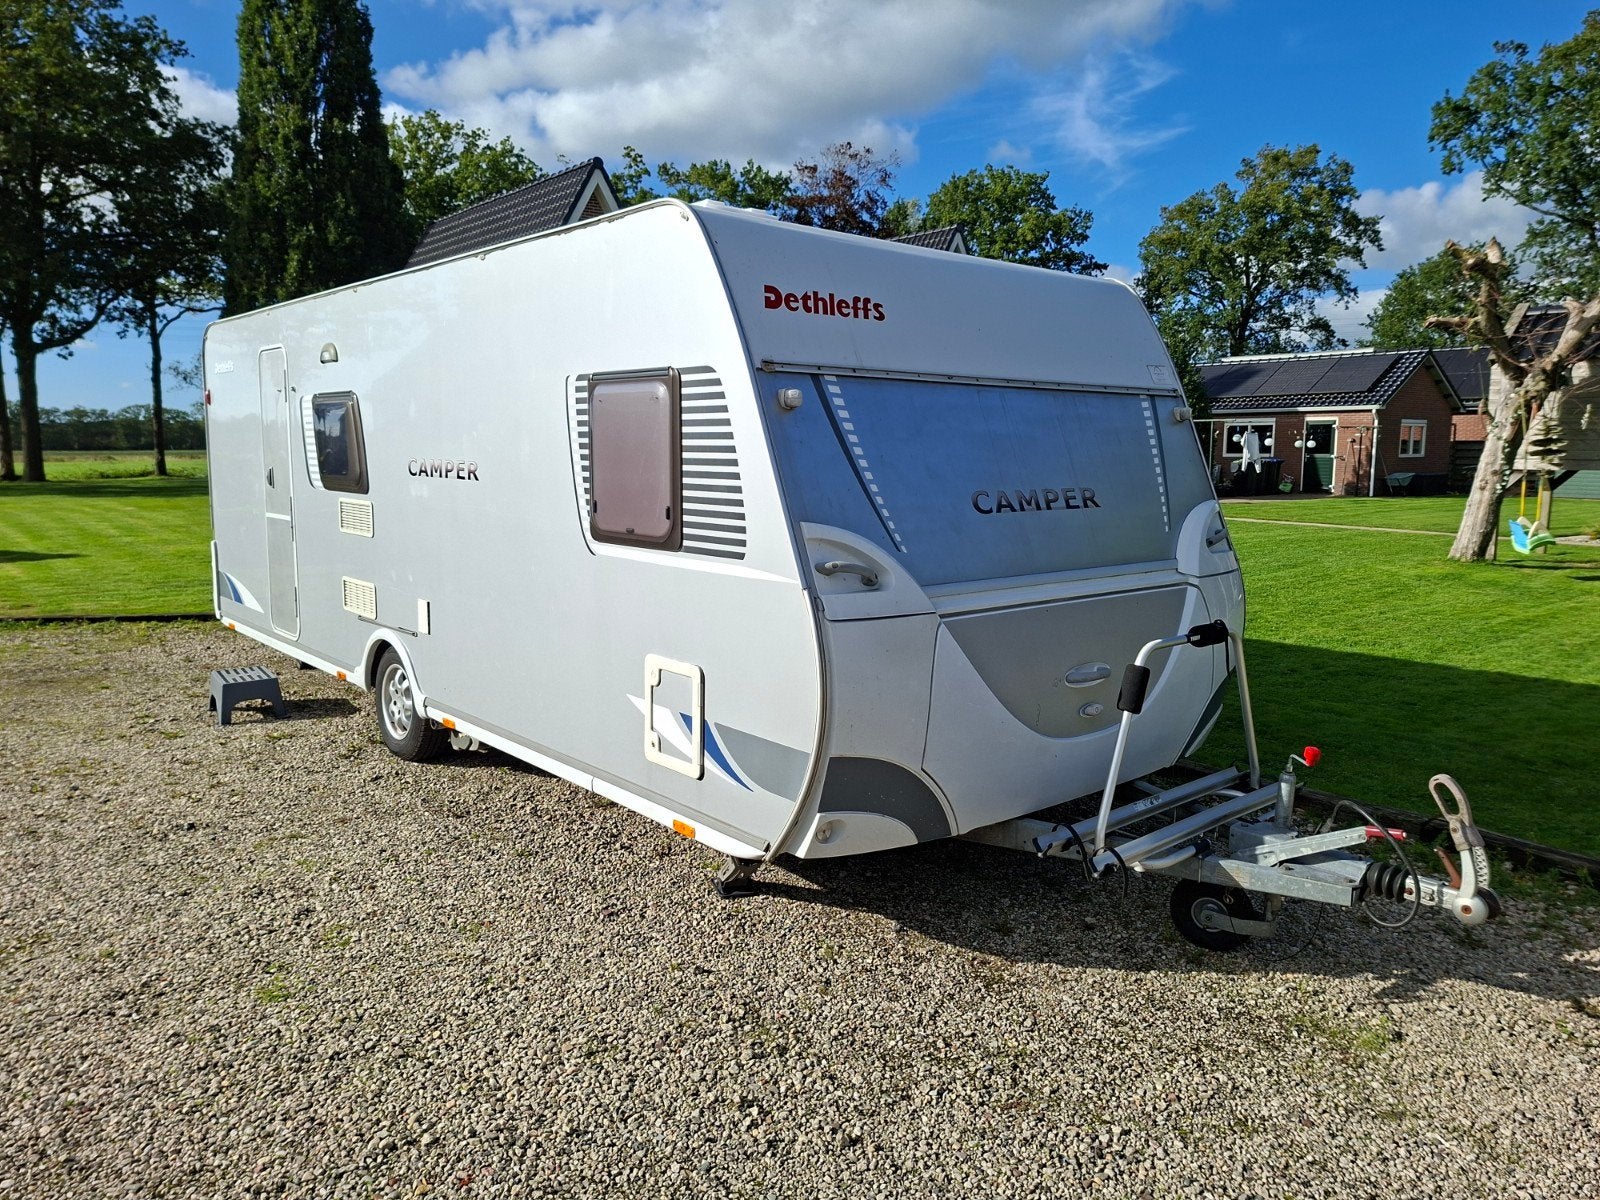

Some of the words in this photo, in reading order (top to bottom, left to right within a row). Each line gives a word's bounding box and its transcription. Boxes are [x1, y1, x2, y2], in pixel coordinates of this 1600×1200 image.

[764, 285, 886, 322] Dethleffs
[408, 457, 479, 481] CAMPER
[972, 486, 1101, 514] CAMPER
